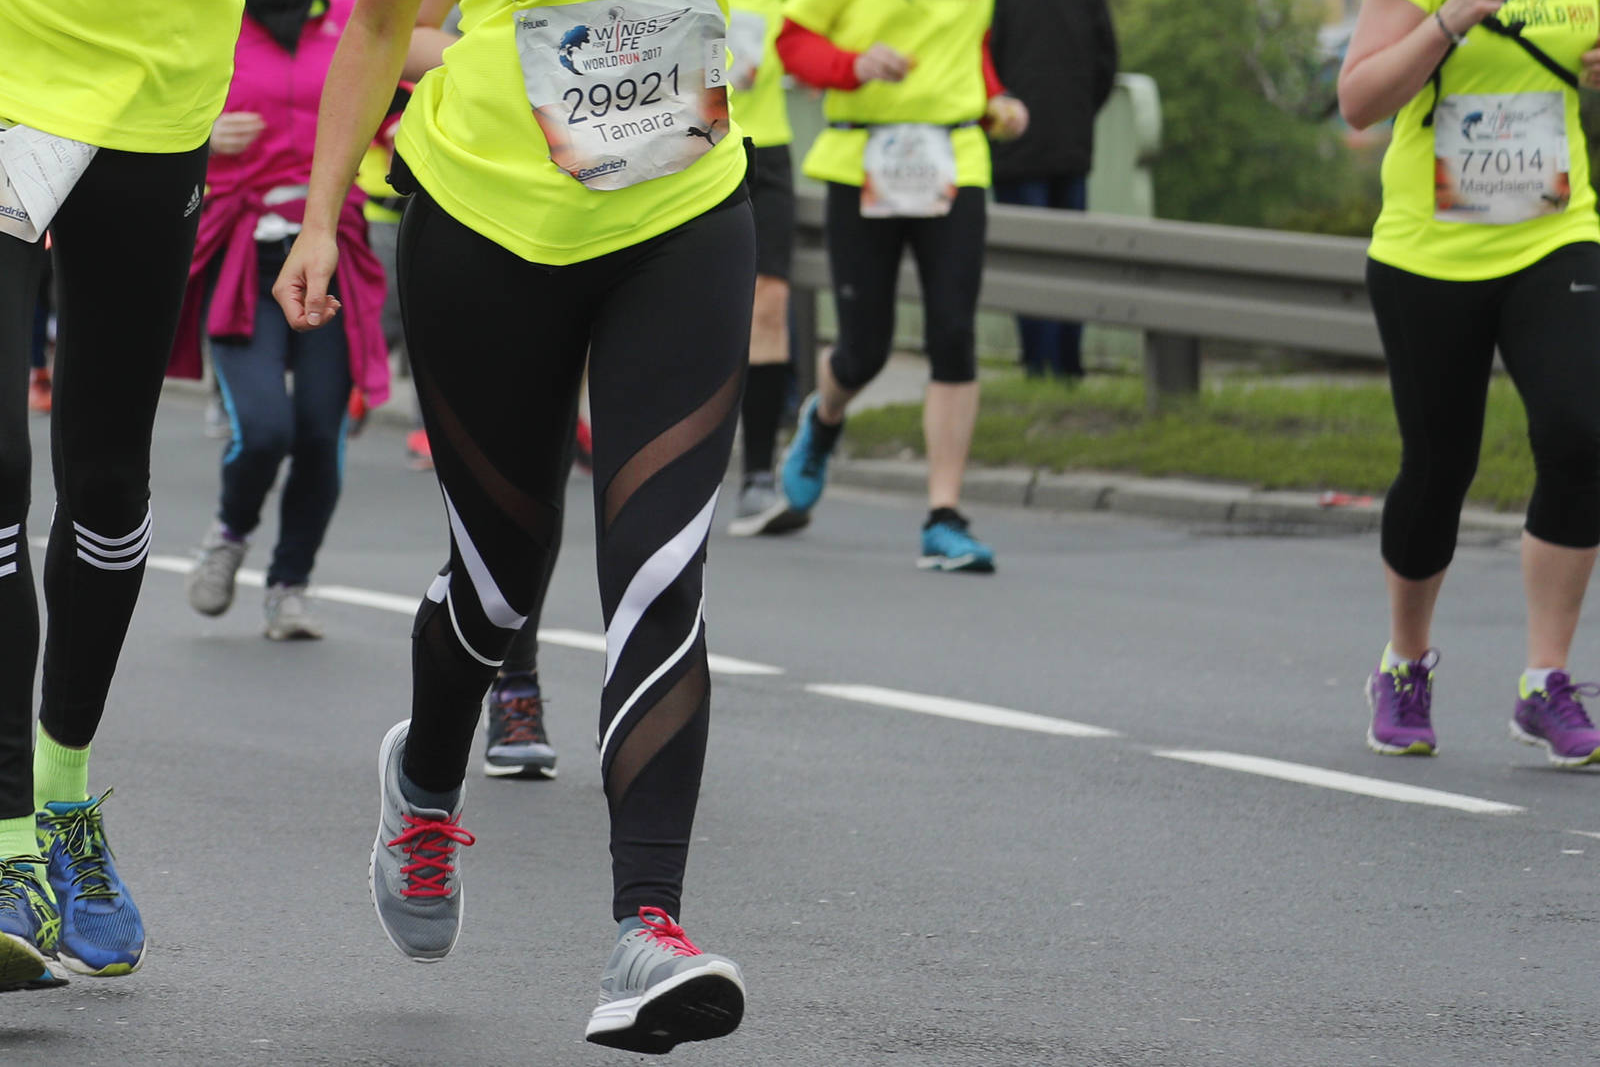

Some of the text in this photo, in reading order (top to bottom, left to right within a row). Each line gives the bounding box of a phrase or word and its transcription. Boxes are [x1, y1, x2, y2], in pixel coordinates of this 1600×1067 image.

[523, 19, 549, 31] POLAND
[594, 19, 657, 40] WINGS
[605, 36, 640, 54] LIFE
[582, 46, 663, 71] WORLD RUN 2017
[710, 68, 721, 83] 3
[562, 63, 679, 124] 29921
[593, 111, 675, 143] Tamara
[1459, 148, 1544, 173] 77014
[1460, 177, 1544, 196] Magdalena
